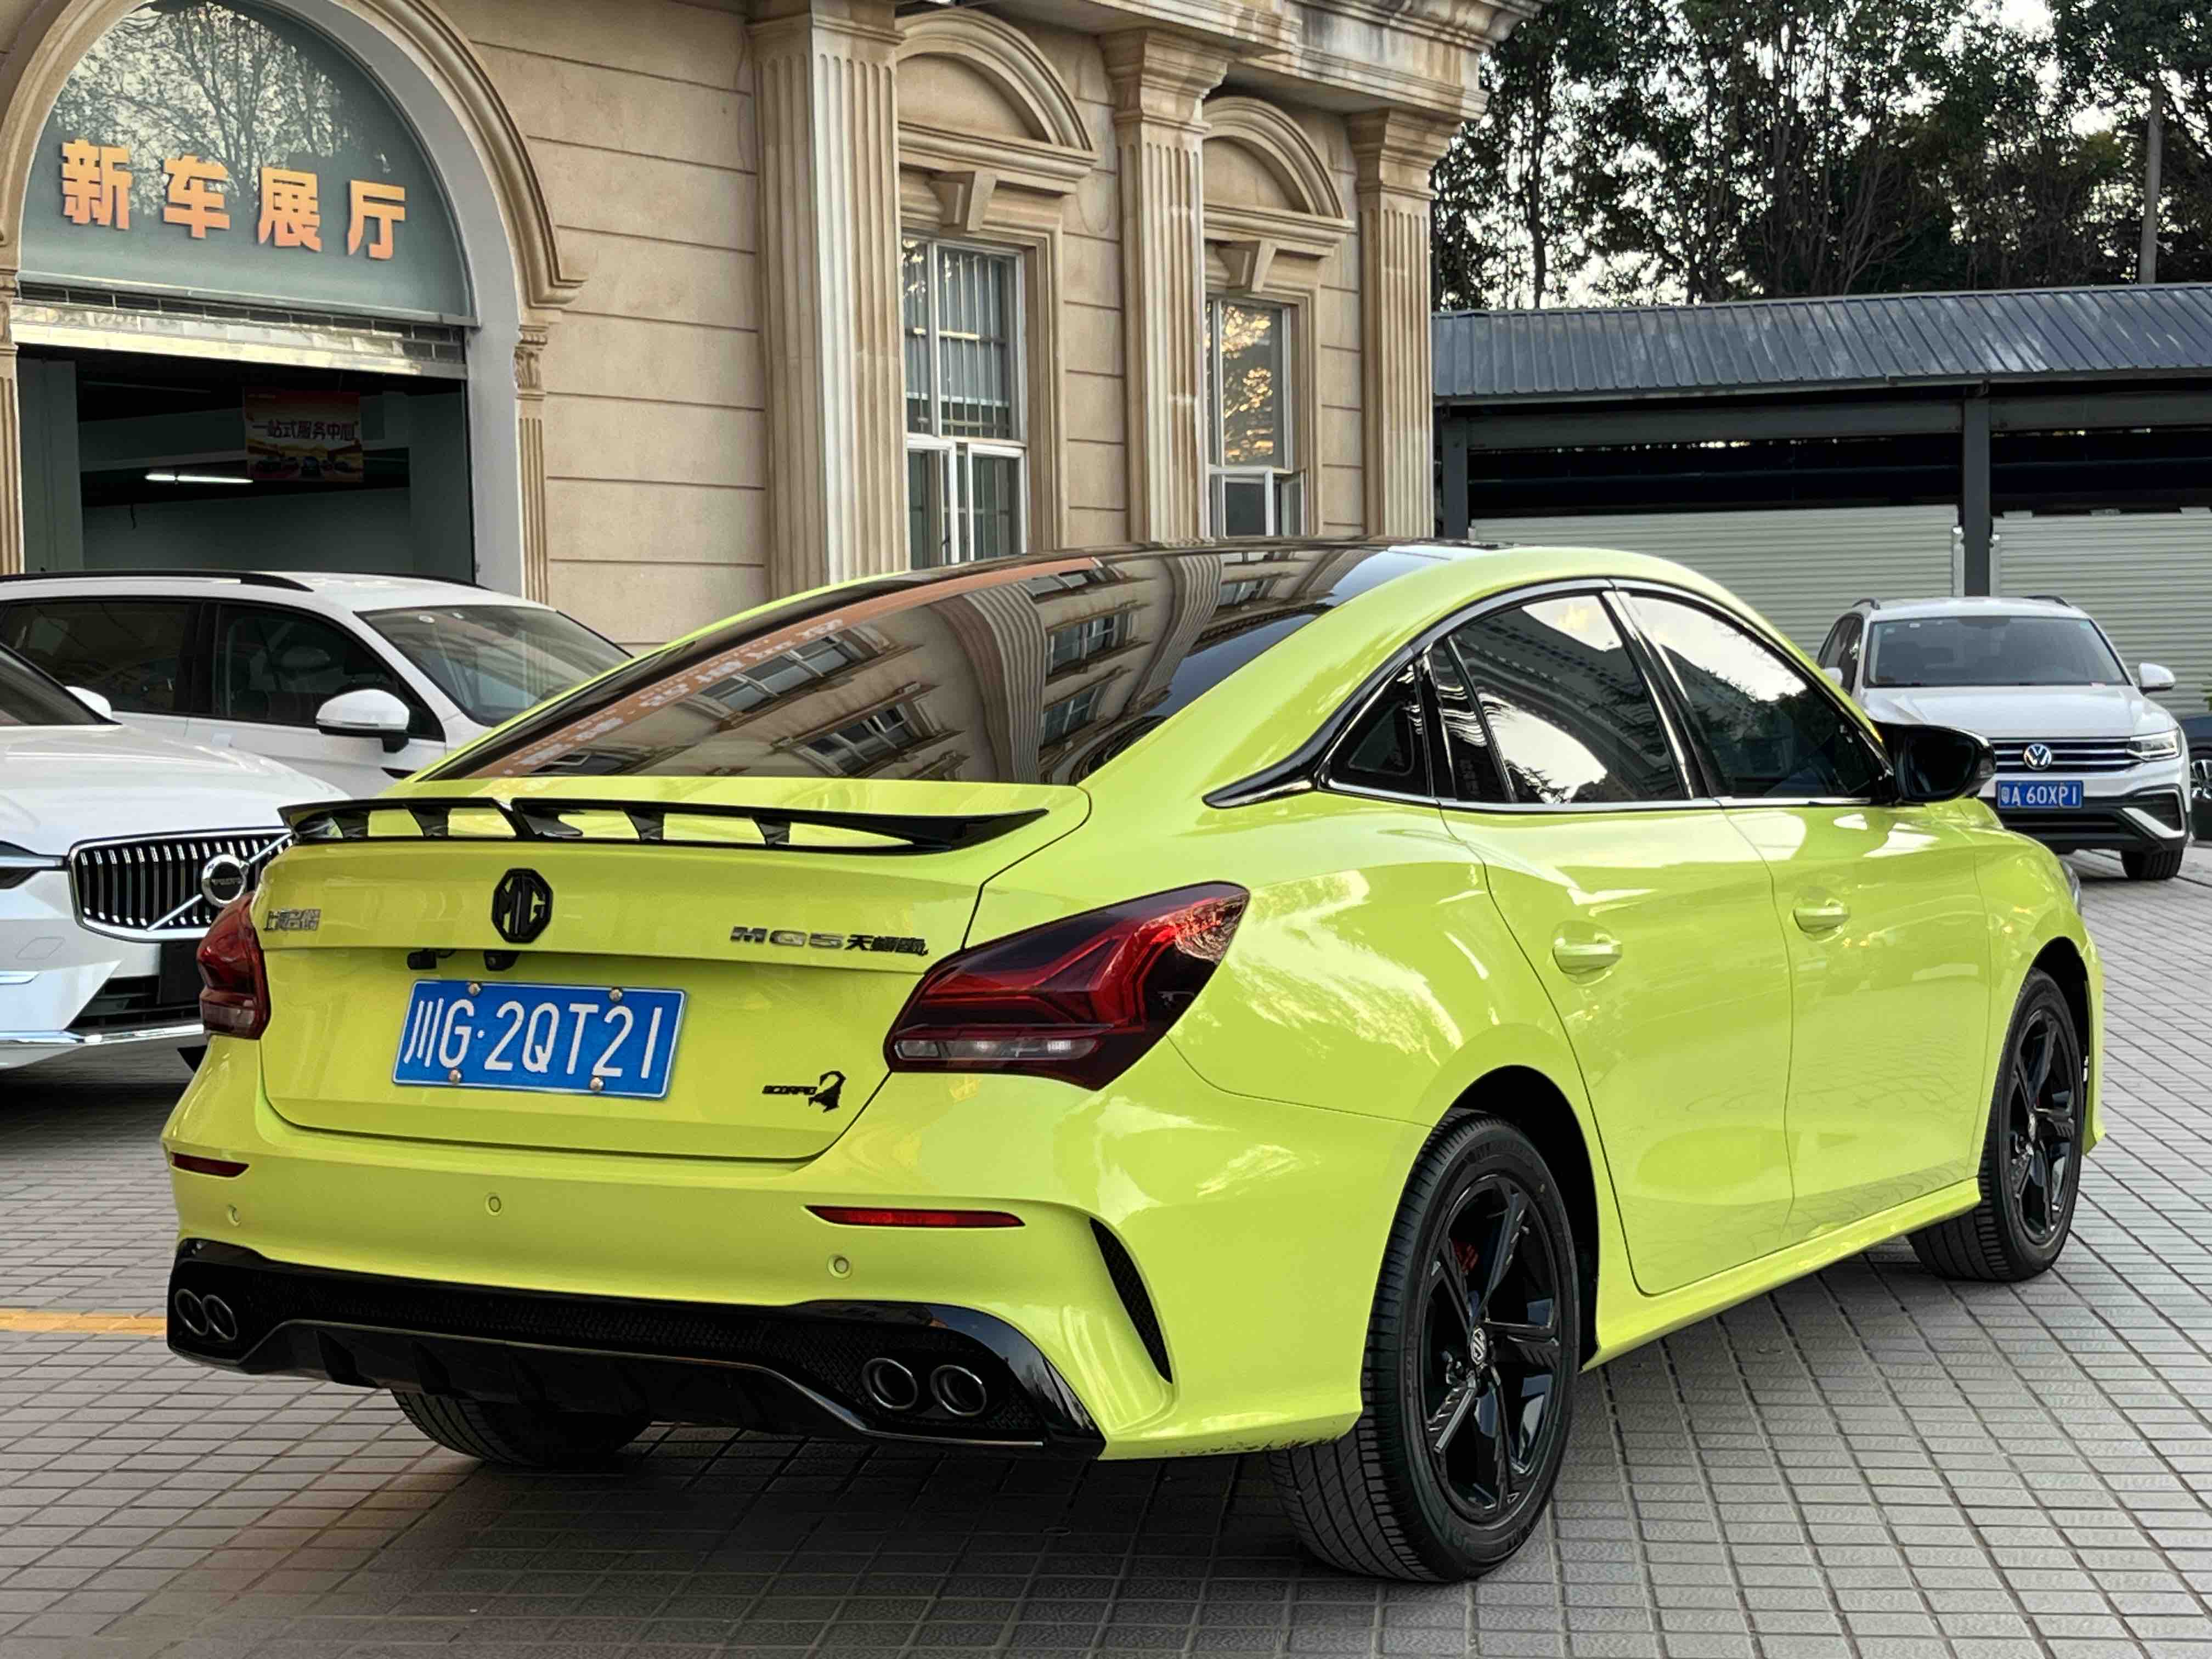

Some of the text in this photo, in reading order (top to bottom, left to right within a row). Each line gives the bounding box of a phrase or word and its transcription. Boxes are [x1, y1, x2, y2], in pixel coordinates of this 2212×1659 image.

[61, 139, 407, 261] 新车展厅
[493, 870, 552, 943] MG
[404, 997, 663, 1079] 川G·2QT21
